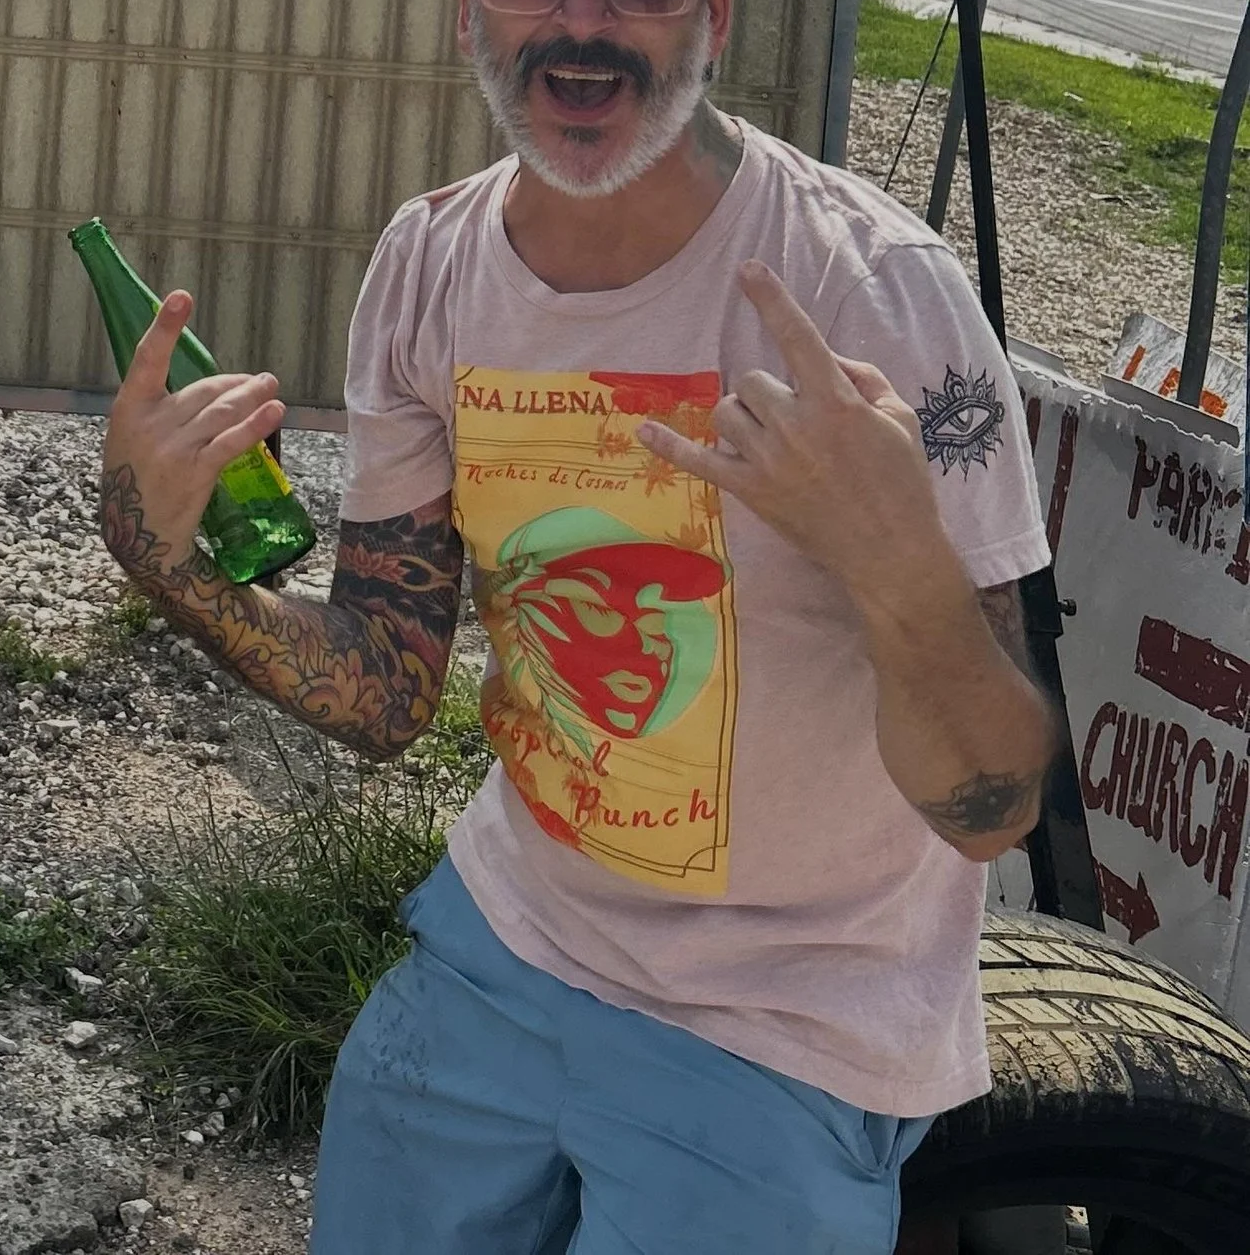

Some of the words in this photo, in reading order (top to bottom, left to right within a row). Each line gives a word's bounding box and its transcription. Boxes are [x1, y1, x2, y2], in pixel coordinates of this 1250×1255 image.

[454, 384, 505, 412] NA
[512, 390, 608, 416] LLENA
[570, 782, 717, 829] Punch
[1080, 701, 1250, 902] CHURCH
